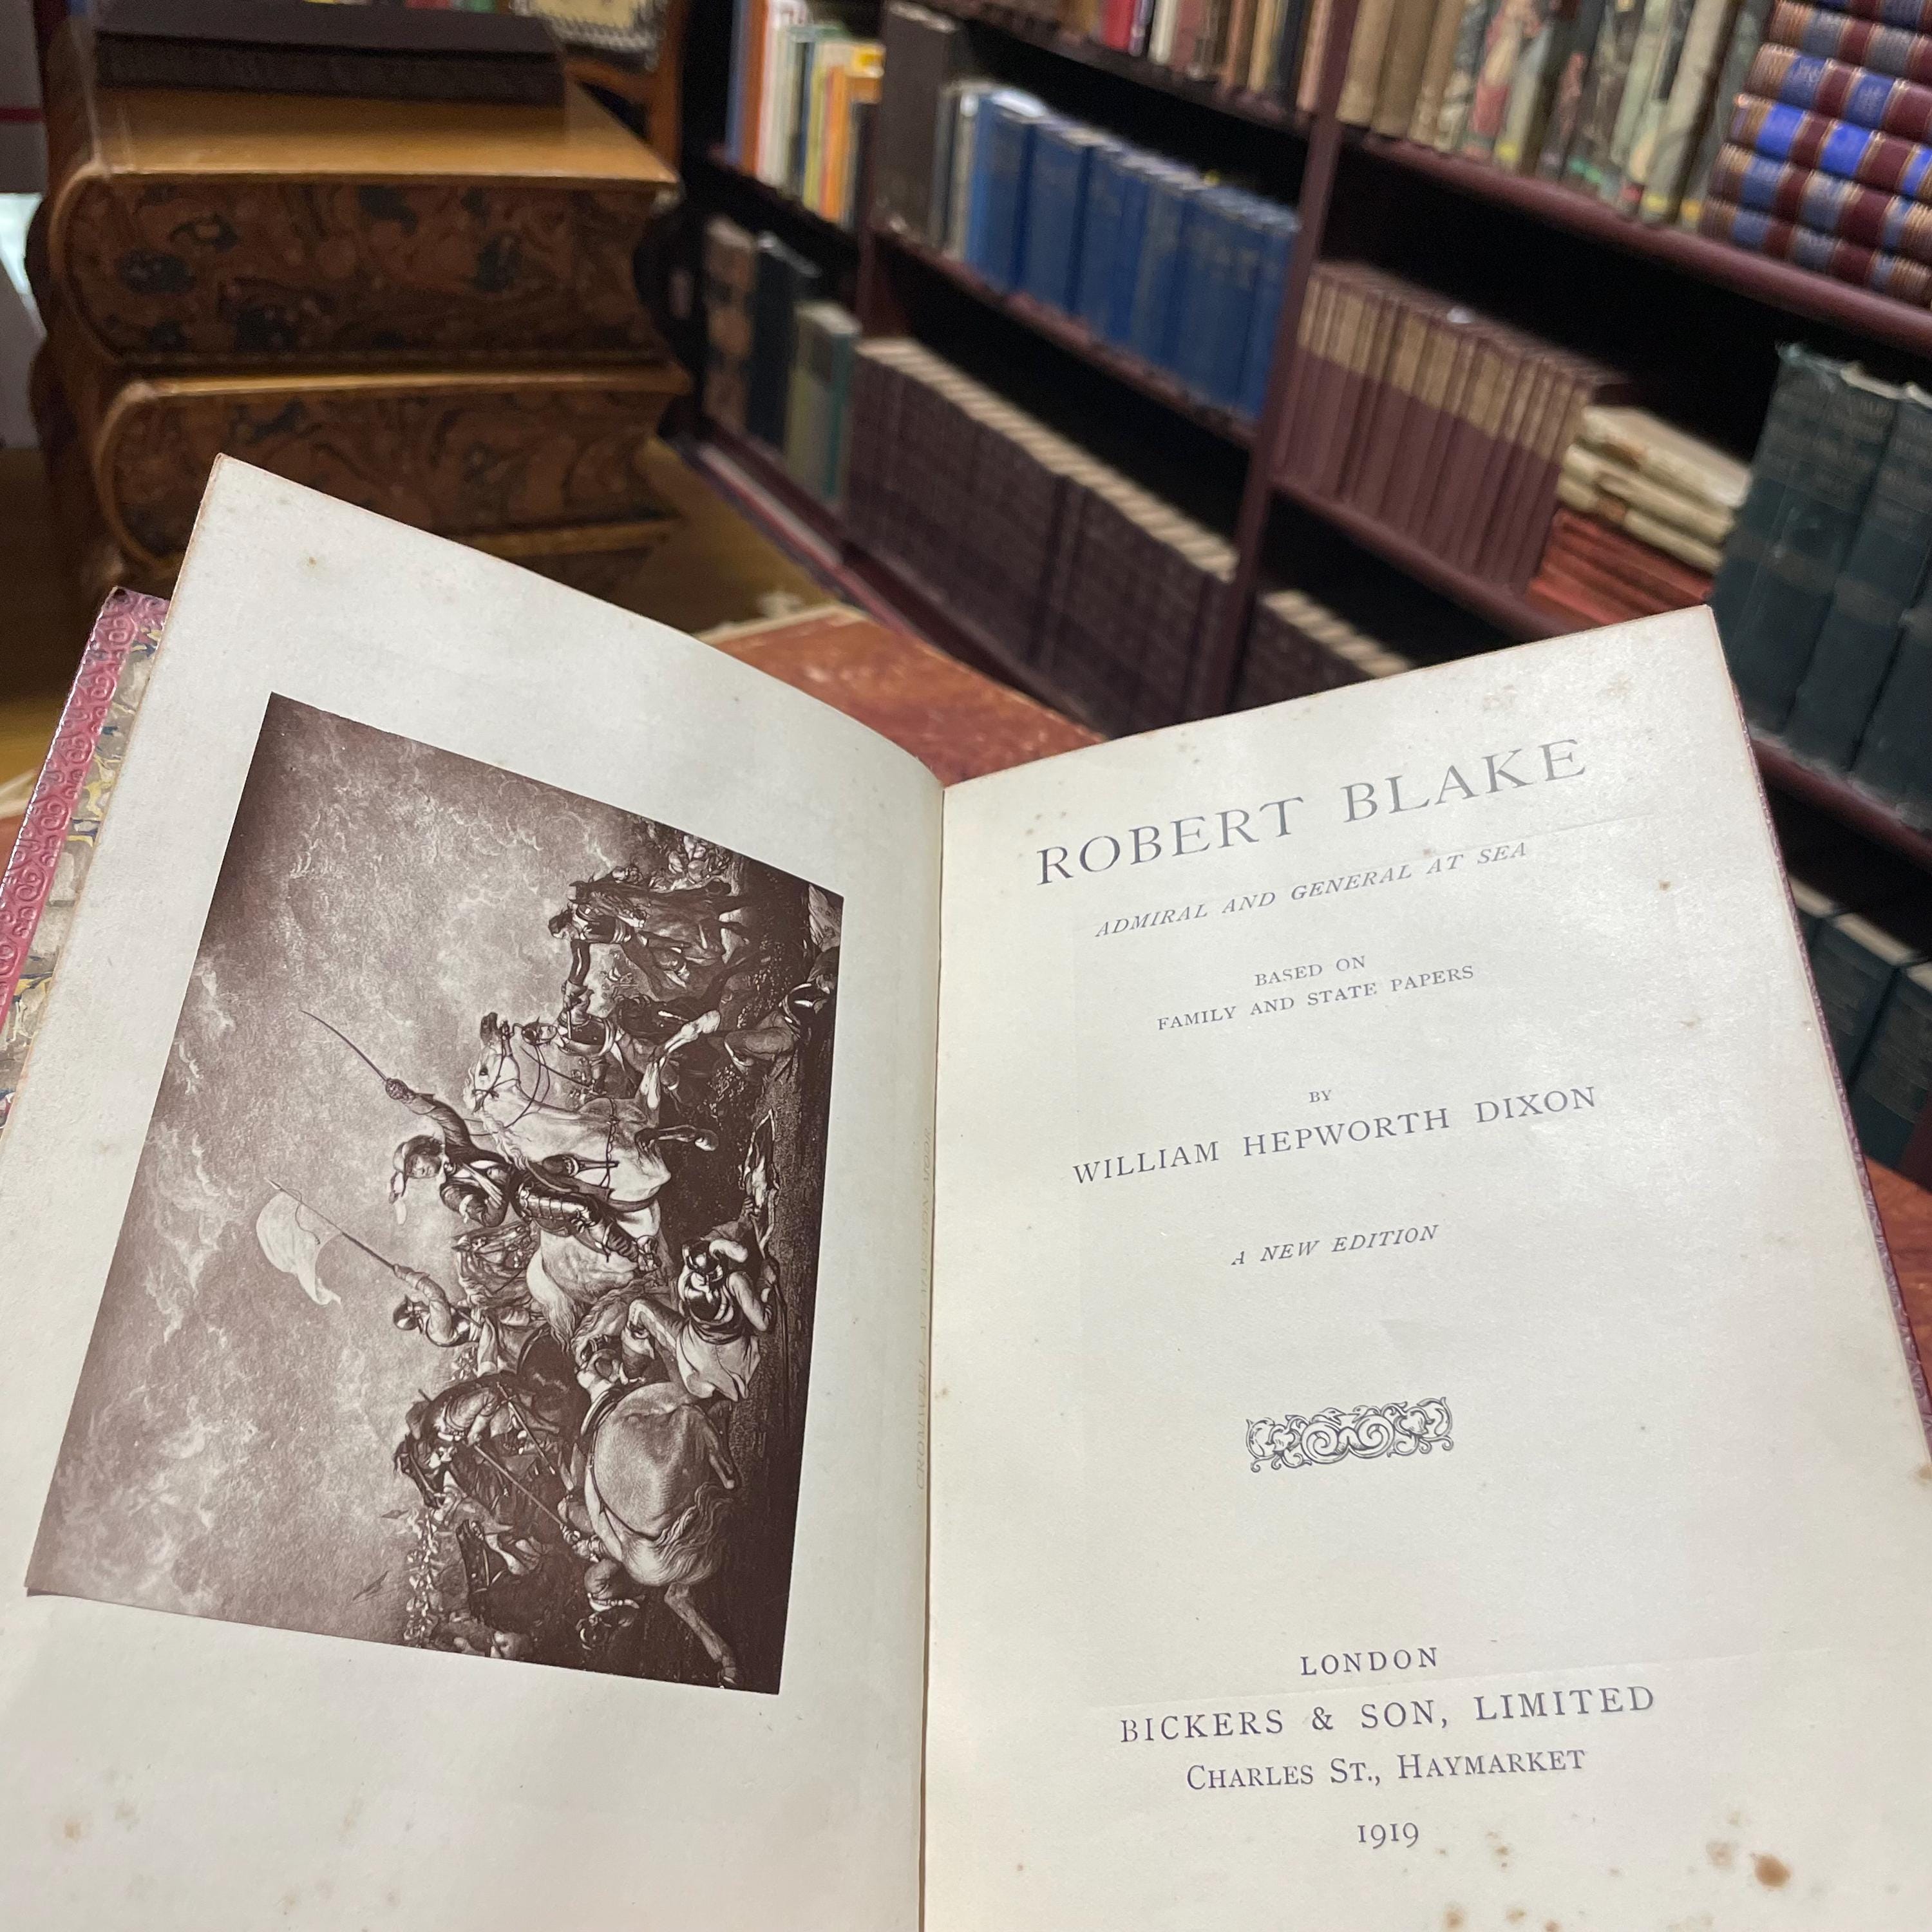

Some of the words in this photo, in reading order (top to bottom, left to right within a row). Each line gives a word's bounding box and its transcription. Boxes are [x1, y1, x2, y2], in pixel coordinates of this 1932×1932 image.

[1037, 797, 1305, 886] ROBERT
[1340, 739, 1585, 822] BLAKE
[1095, 904, 1208, 937] ADMIRAL
[1222, 893, 1275, 913] AND
[1291, 865, 1412, 900] GENERAL
[1426, 853, 1463, 875] AT
[1477, 842, 1526, 864] SEA
[1157, 1006, 1236, 1030] FAMILY
[1250, 998, 1294, 1015] AND
[1308, 983, 1377, 1005] STATE
[1391, 965, 1473, 992] PAPERS
[1255, 965, 1322, 986] BASED
[1336, 956, 1365, 971] ON
[1309, 1090, 1331, 1103] BY
[1072, 1141, 1218, 1184] WILLIAM
[1243, 1107, 1449, 1156] HEPWORTH
[1475, 1086, 1595, 1122] DIXON
[1231, 1251, 1244, 1265] A
[1260, 1240, 1320, 1262] NEW
[1331, 1225, 1439, 1252] EDITION
[916, 1358, 926, 1490] CROMWELL
[1300, 1647, 1437, 1676] LONDON
[1121, 1710, 1282, 1743] BICKERS
[1312, 1707, 1333, 1730] &
[1361, 1700, 1447, 1728] SON,
[1473, 1687, 1653, 1720] LIMITED
[1358, 1823, 1419, 1850] 1919
